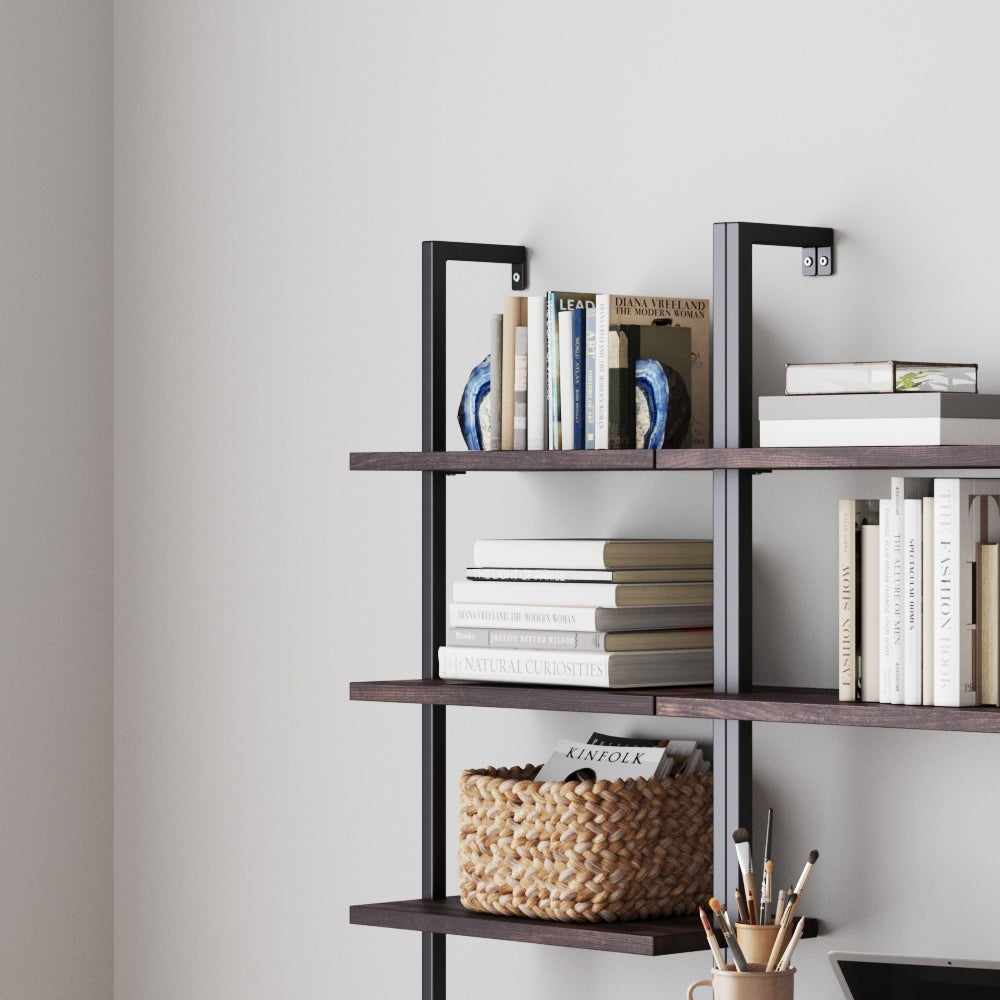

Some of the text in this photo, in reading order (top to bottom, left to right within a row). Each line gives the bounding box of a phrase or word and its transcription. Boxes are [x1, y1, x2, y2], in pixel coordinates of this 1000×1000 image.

[615, 297, 706, 311] DIANA VREELAND
[615, 306, 706, 319] THE MODERN WOMAN
[587, 330, 596, 359] ART
[842, 565, 850, 611] SHOW
[893, 535, 901, 646] THE ALLURE OF MEN
[940, 489, 952, 691] THE FASHION BOOK
[458, 610, 576, 625] DIANA VREELAND THE MODERN WOMAN
[842, 618, 850, 687] FASHION
[464, 657, 522, 674] NATURAL
[525, 660, 604, 678] CURIOSITIES
[565, 747, 647, 765] KINFOLK
